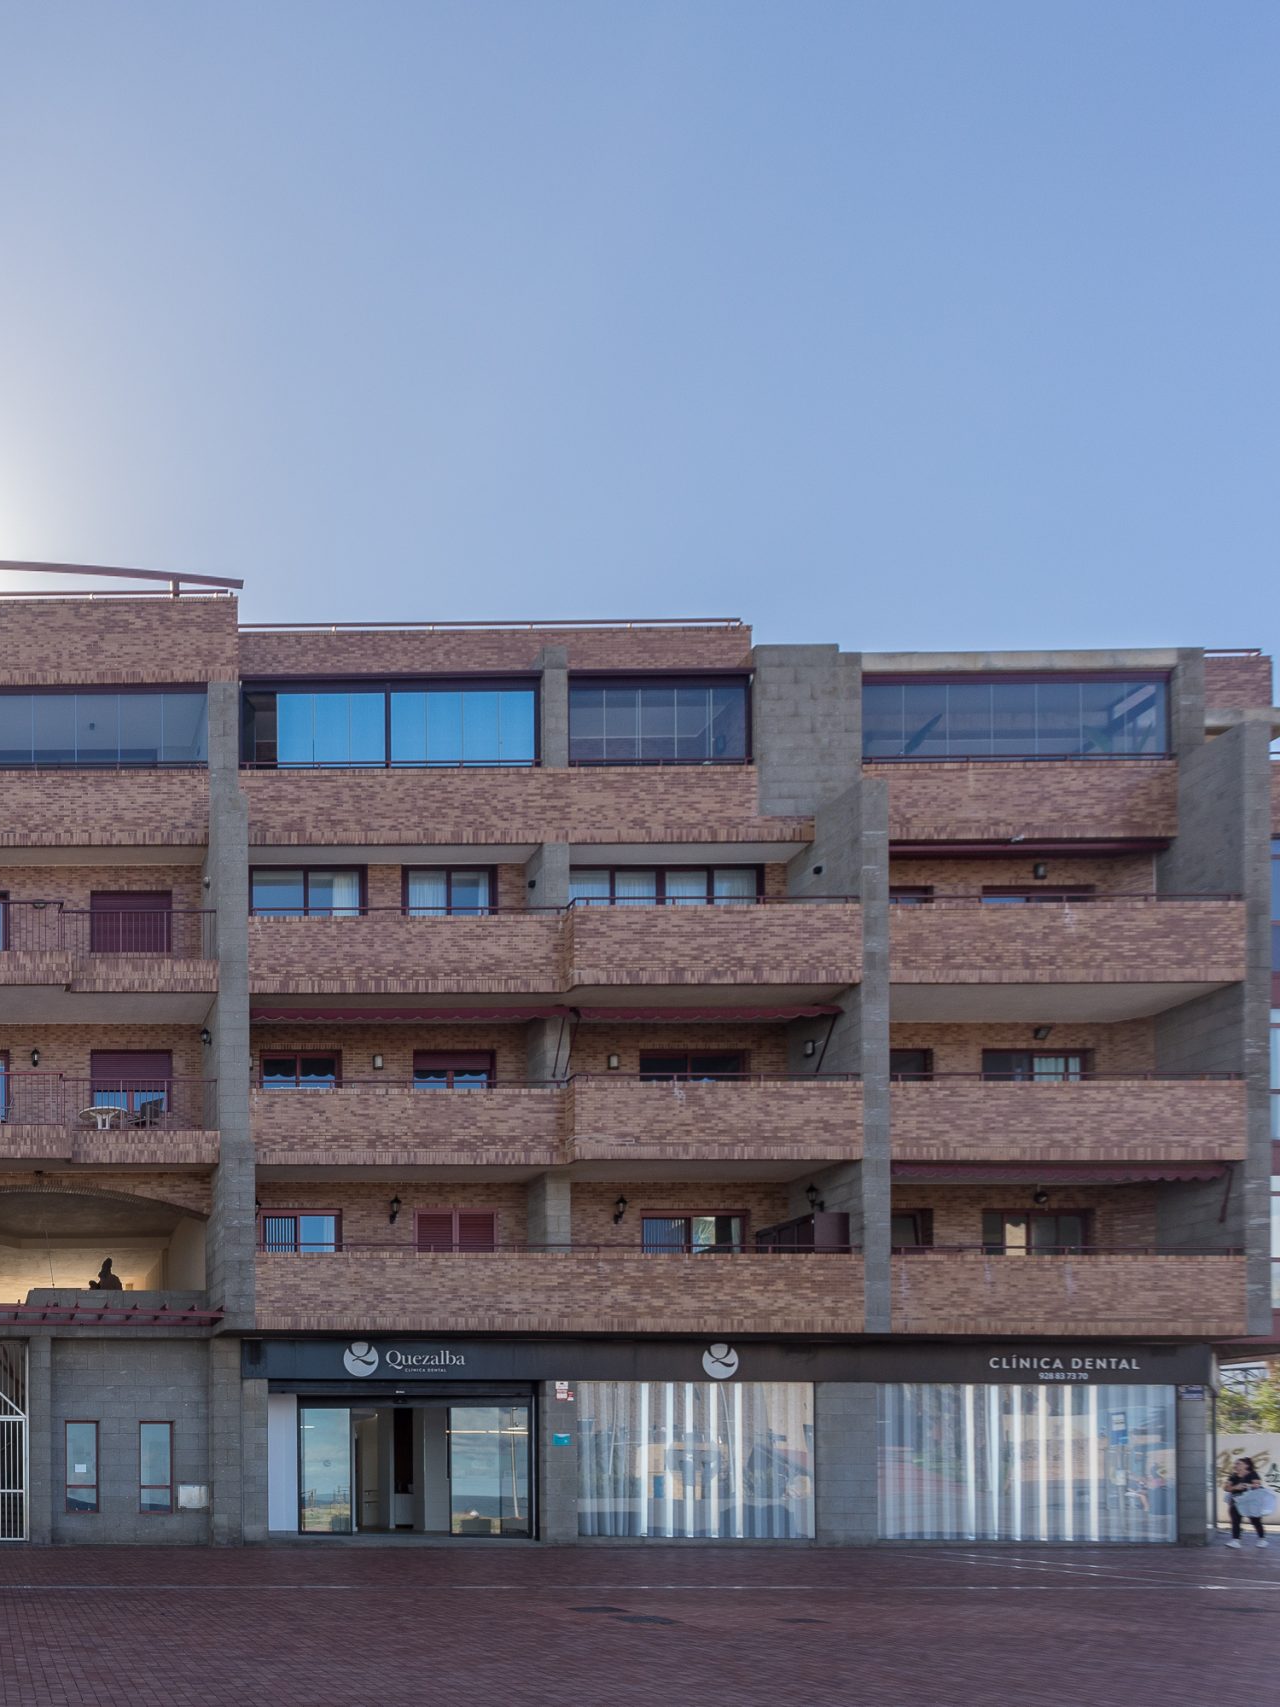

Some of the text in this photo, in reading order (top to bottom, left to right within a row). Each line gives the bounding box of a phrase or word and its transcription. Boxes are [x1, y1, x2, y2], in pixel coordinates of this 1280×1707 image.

[385, 1350, 465, 1370] Quezalba
[989, 1354, 1141, 1370] CLÍNICA DENTAL
[1038, 1372, 1054, 1380] 928
[1066, 1372, 1077, 1380] 73
[1077, 1372, 1088, 1380] 70
